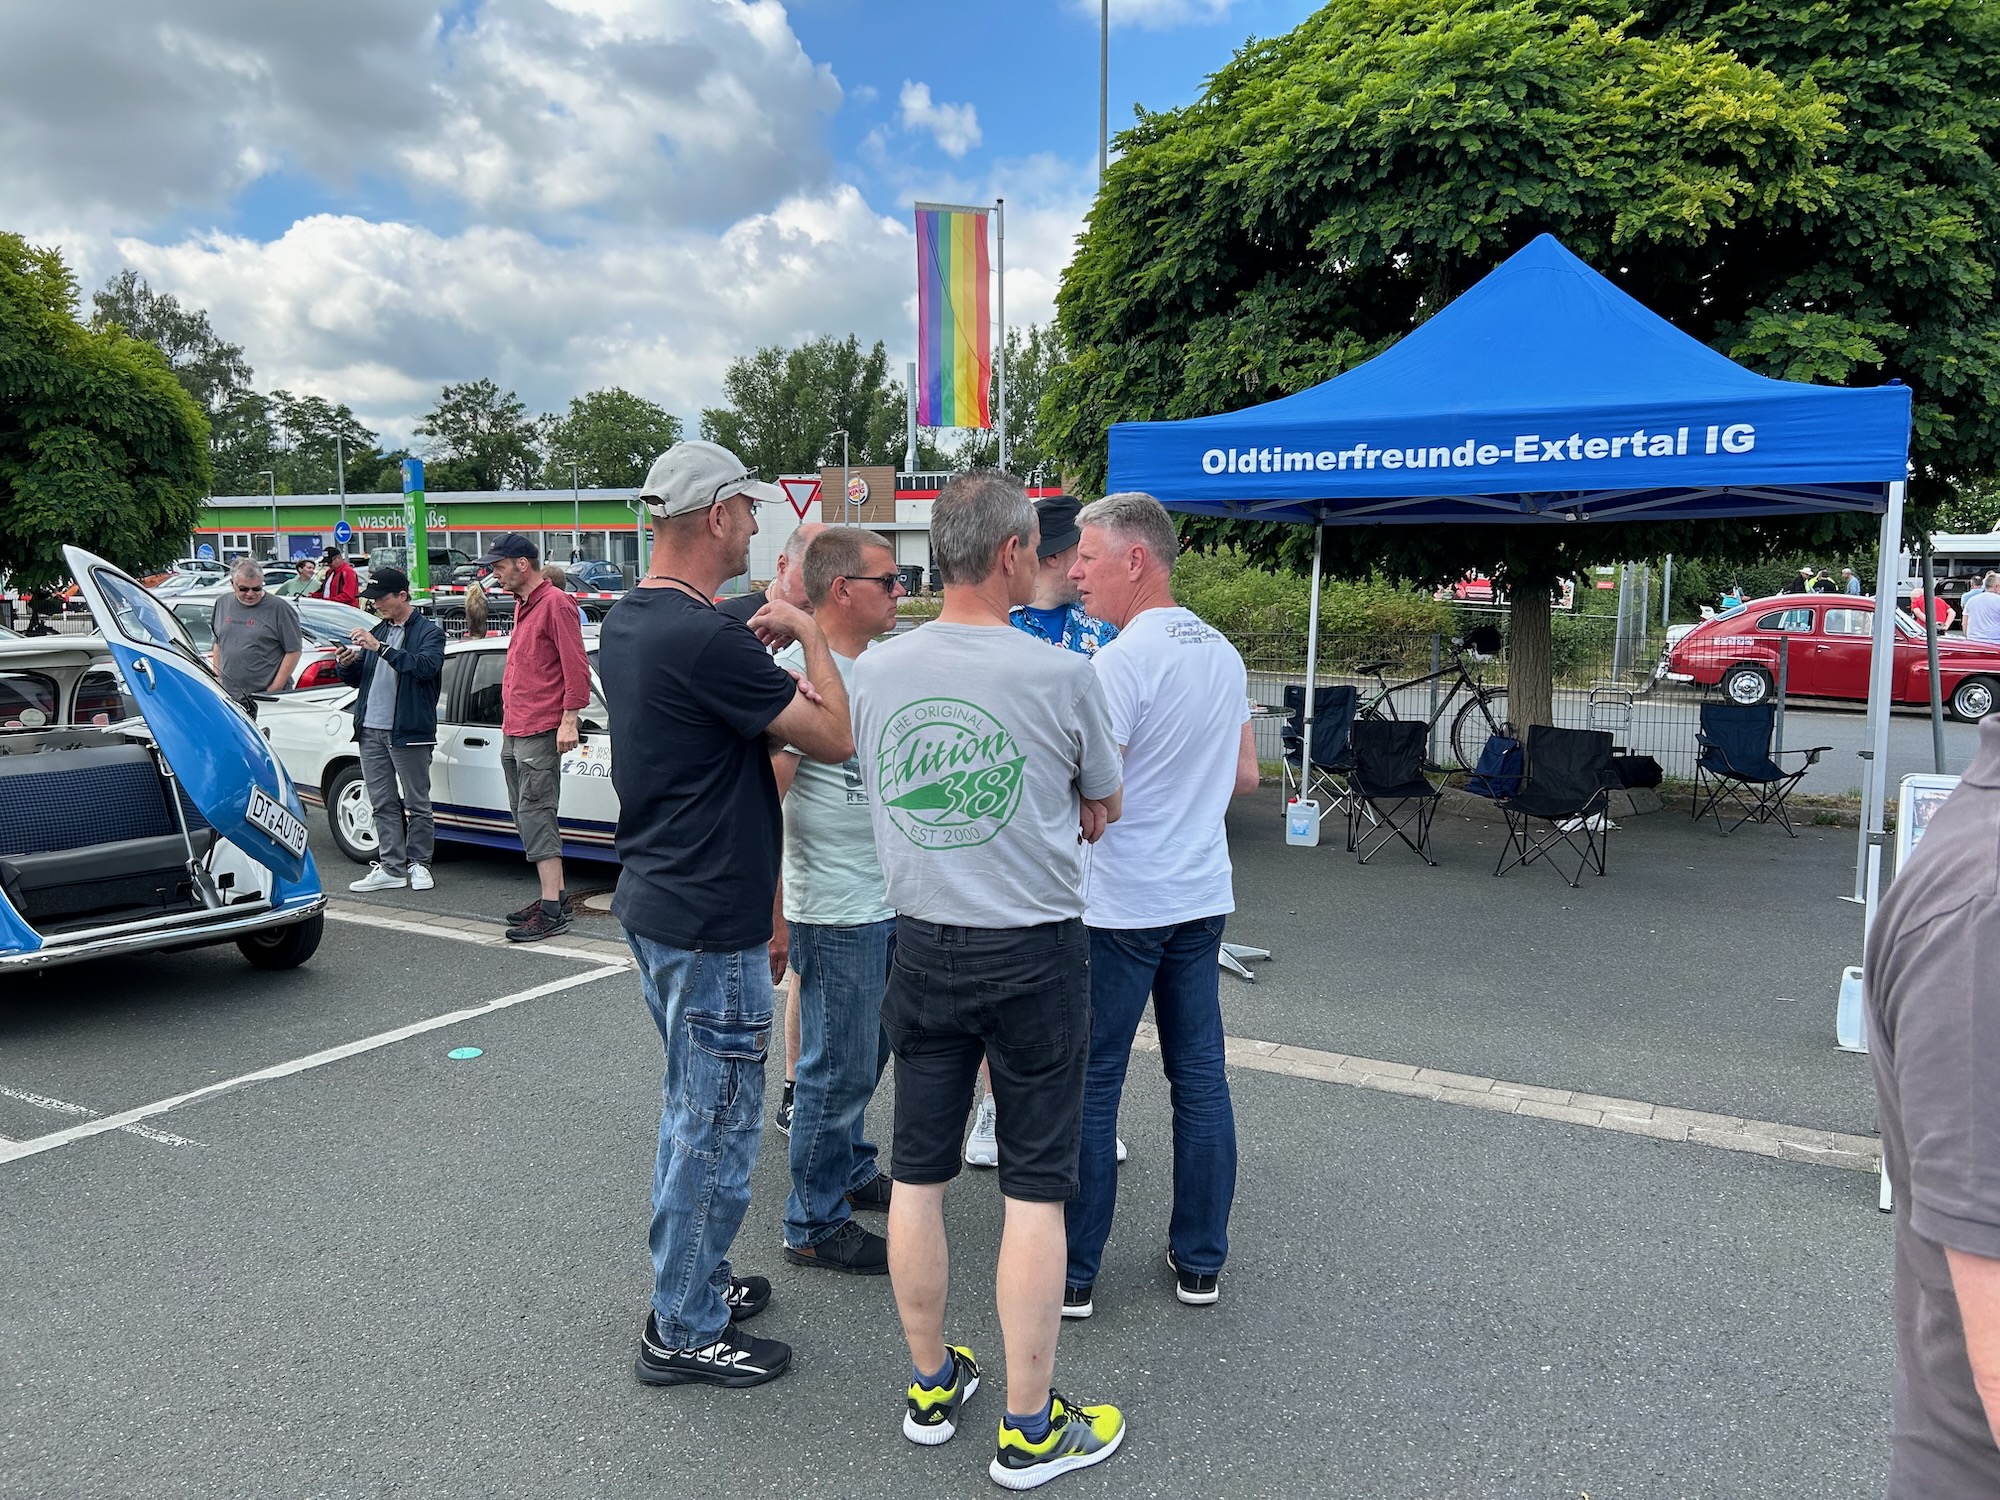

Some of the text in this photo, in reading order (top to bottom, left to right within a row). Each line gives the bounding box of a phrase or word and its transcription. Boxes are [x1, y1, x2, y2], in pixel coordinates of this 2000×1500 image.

[1202, 423, 1755, 474] Oldtimerfreunde-Extertal IG
[358, 510, 447, 529] waschße
[888, 705, 984, 738] THE ORIGINAL
[877, 730, 1013, 797] Edition
[252, 793, 272, 823] DT
[847, 793, 870, 802] RE
[934, 764, 1015, 823] 38
[910, 825, 981, 843] EST 2000
